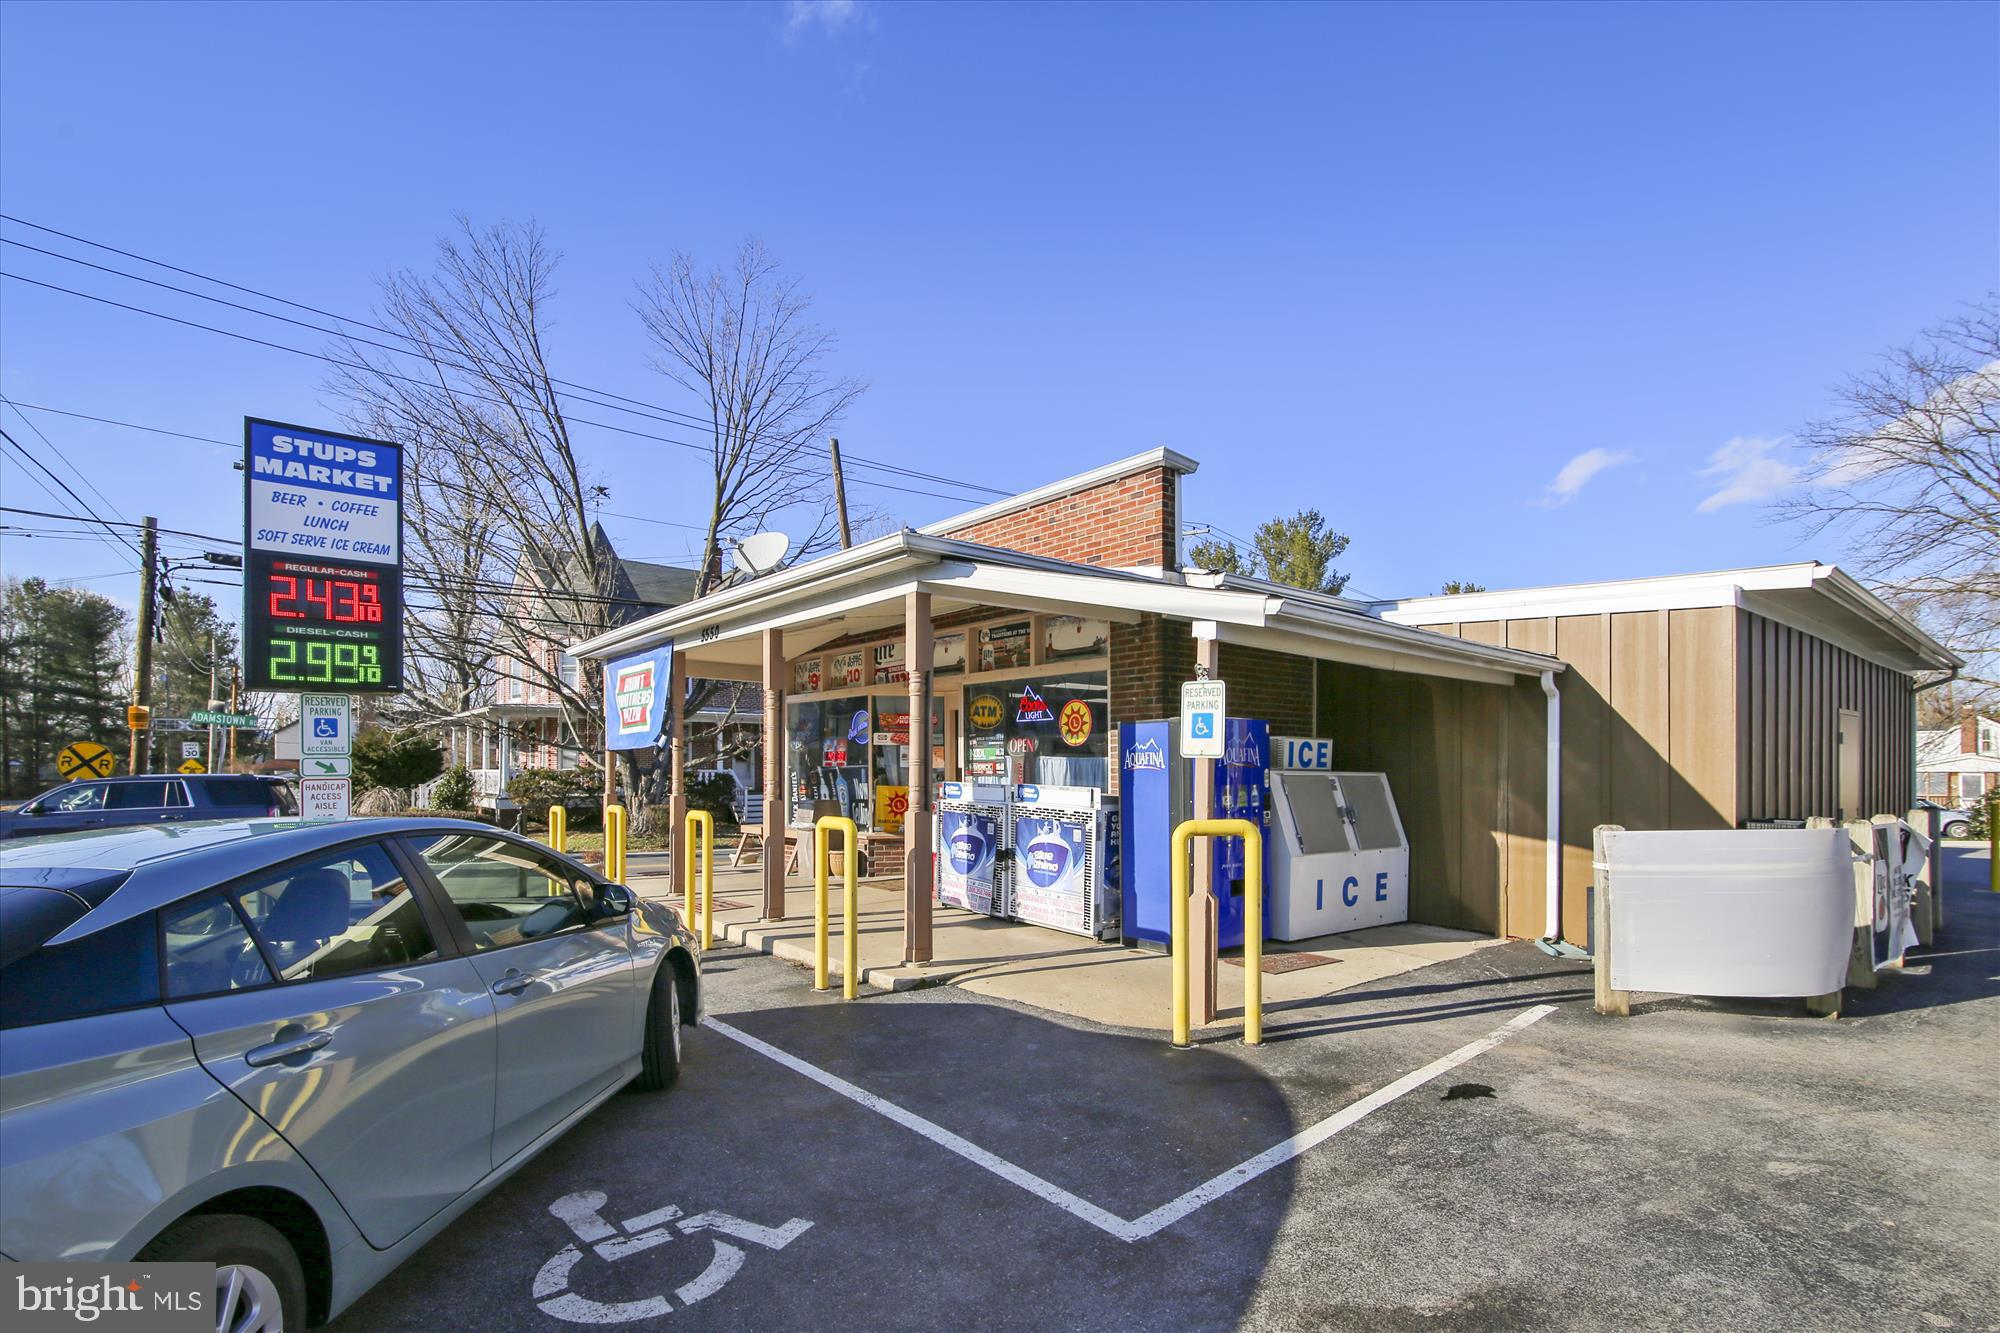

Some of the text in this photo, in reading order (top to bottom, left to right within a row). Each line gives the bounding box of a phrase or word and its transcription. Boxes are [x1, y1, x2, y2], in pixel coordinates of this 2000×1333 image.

[272, 435, 377, 468] STUPS
[254, 455, 393, 492] MARKET
[271, 491, 379, 517] BEER COFFEE
[303, 515, 349, 532] LUNCH
[257, 529, 391, 556] SOFT SERVE ICE CREAM
[284, 563, 368, 578] REGULAR-CASH
[270, 575, 359, 622] 2.43
[286, 626, 368, 639] DIESEL-CASH
[270, 639, 359, 683] 2.99
[1185, 687, 1221, 698] RESERVED
[304, 696, 346, 707] RESERVED
[1020, 696, 1047, 712] Coors
[1187, 700, 1219, 710] PARKING
[309, 707, 341, 716] PARKING
[973, 705, 997, 718] ATM
[1025, 710, 1042, 719] LIGHT
[191, 712, 246, 725] ADAMSTOWN
[1010, 738, 1035, 753] OPEN
[61, 755, 73, 767] R
[1123, 748, 1166, 769] AQUAFINA
[1288, 741, 1329, 768] ICE
[99, 759, 110, 770] R
[305, 783, 346, 791] HANDICAP
[310, 792, 342, 801] ACCESS
[314, 802, 337, 810] AISLE
[956, 841, 972, 851] Blue
[1034, 850, 1054, 861] Blue
[1032, 859, 1059, 872] Rhino
[1316, 872, 1388, 910] ICE
